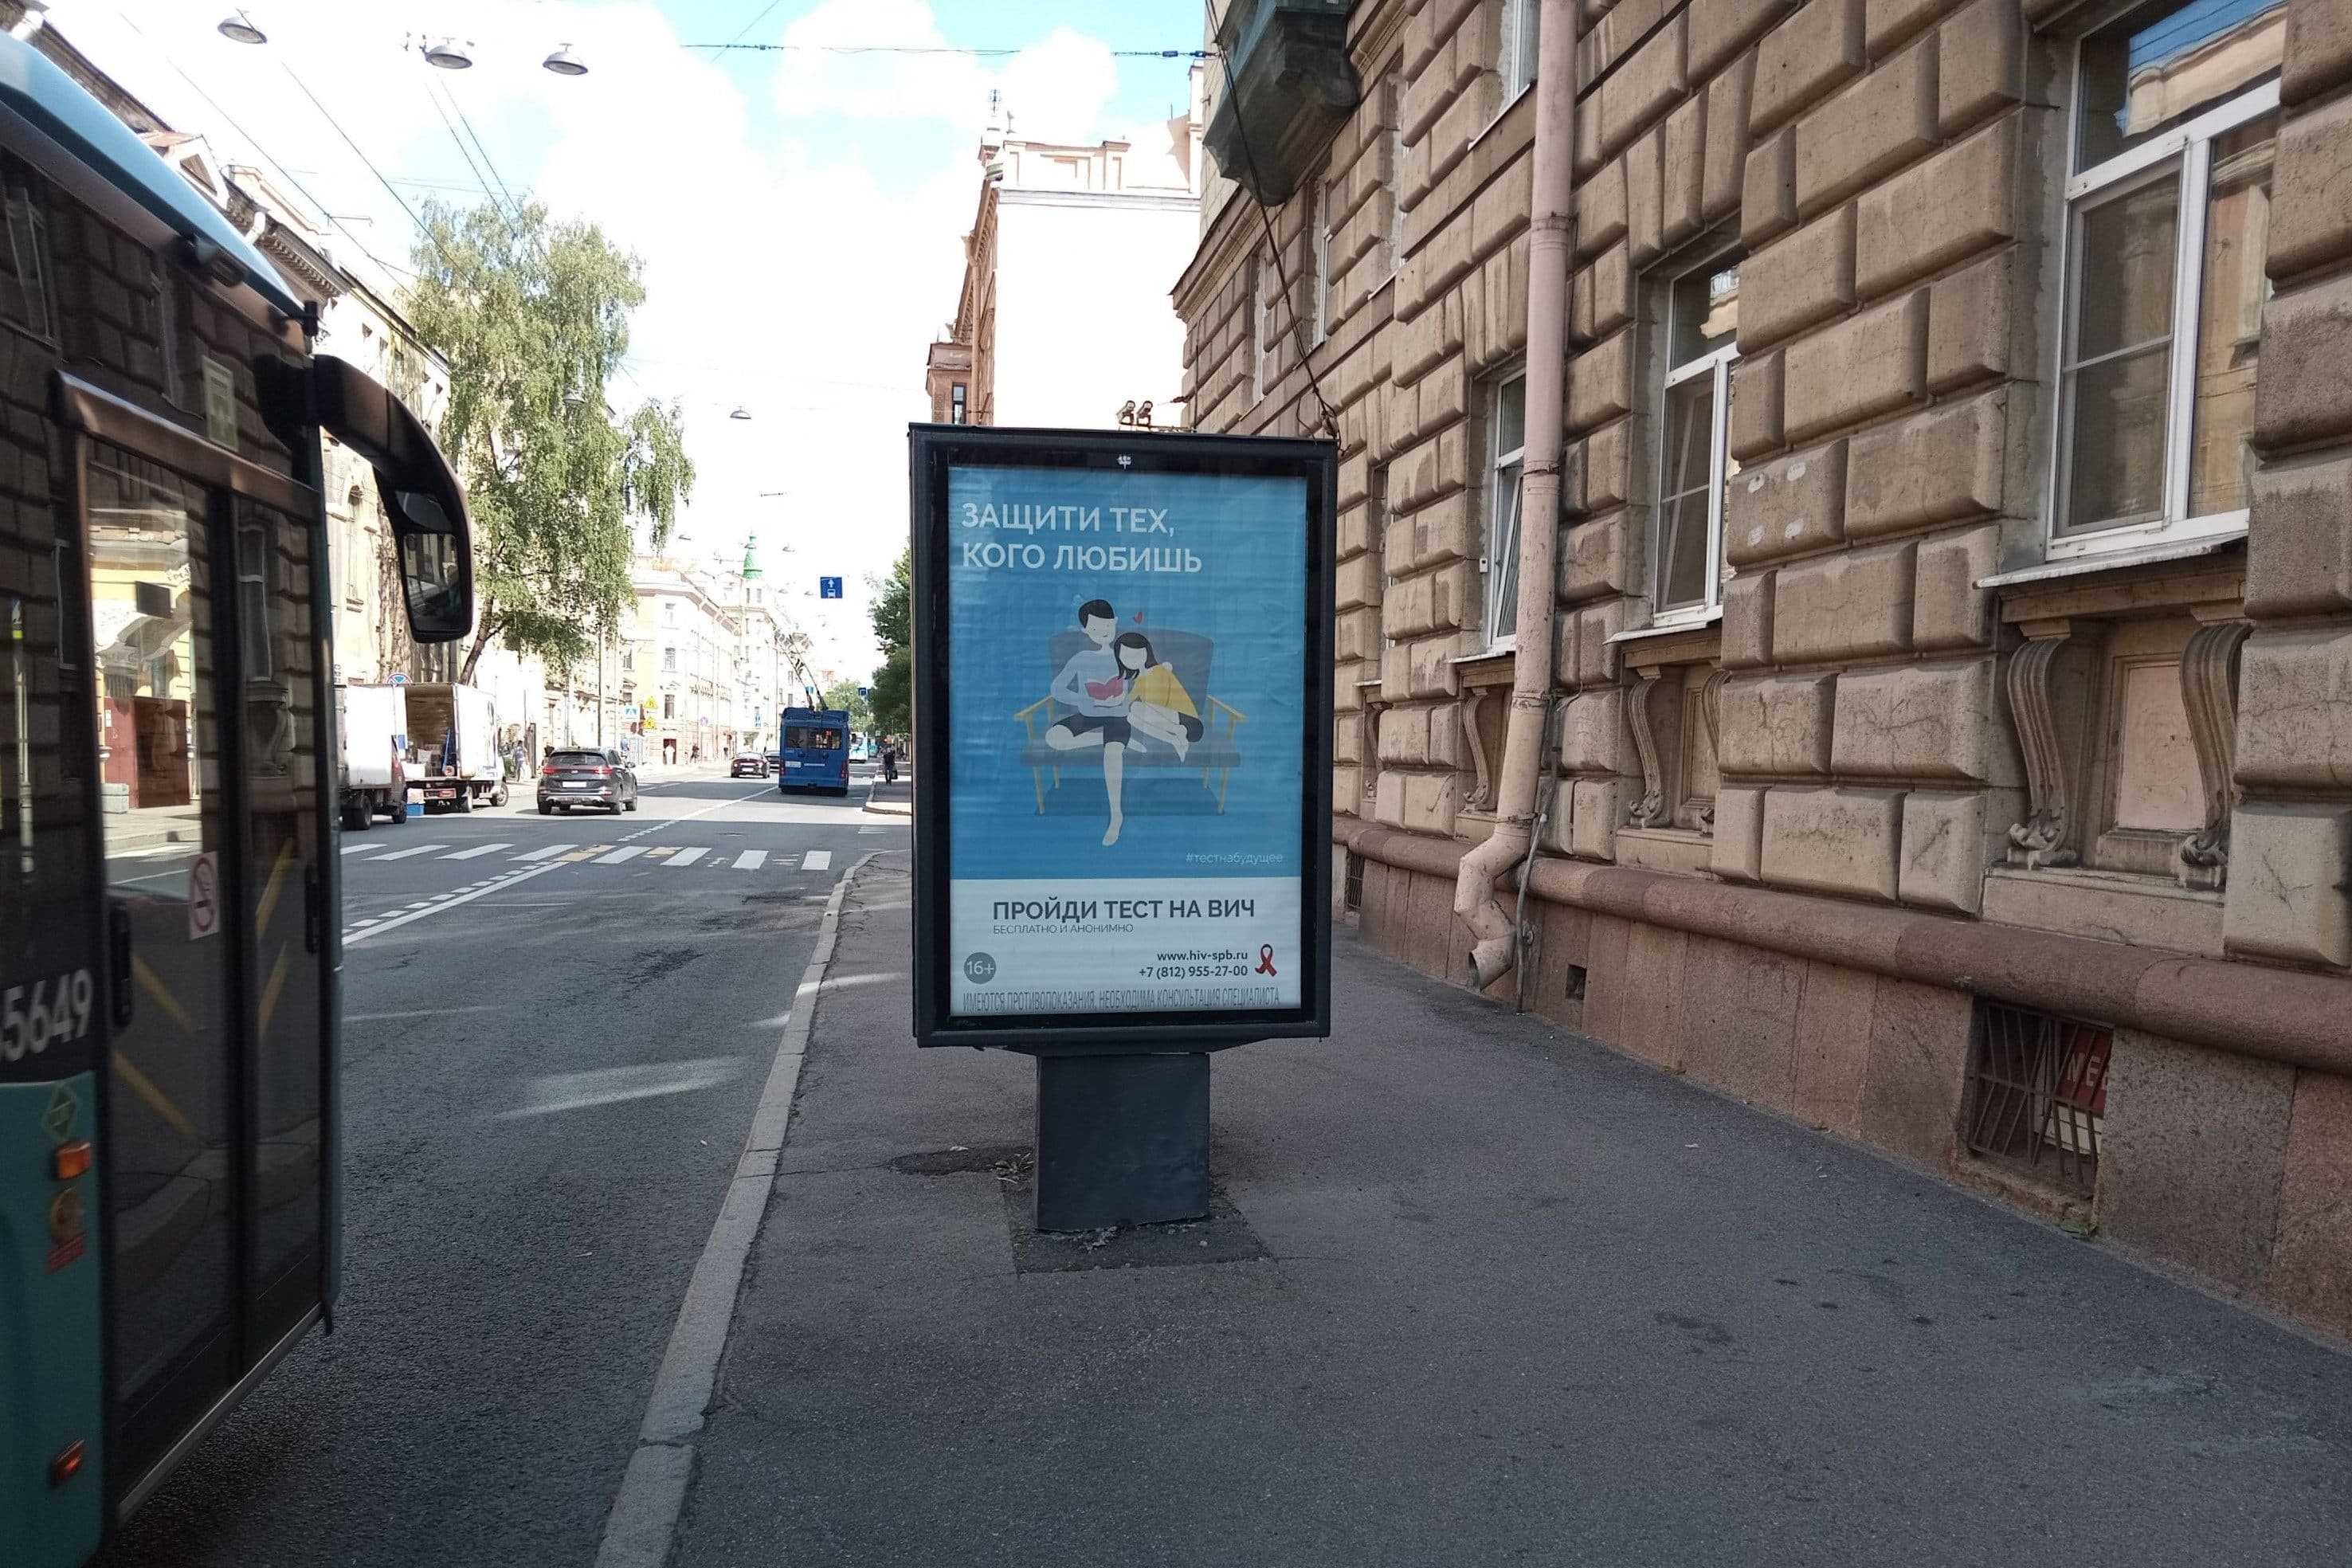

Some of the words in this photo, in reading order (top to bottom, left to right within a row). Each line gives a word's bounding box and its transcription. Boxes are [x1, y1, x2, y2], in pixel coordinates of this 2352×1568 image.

[961, 502, 1100, 535] ЗАЩИТИ
[1109, 507, 1175, 537] ТЕХ,
[962, 542, 1045, 570] КОГО
[1053, 545, 1203, 573] ЛЮБИШЬ
[1186, 852, 1284, 865] #тестнабудущее
[994, 896, 1097, 923] ПРОЙДИ
[1103, 900, 1163, 919] ТЕСТ
[1170, 900, 1201, 918] НА
[1208, 899, 1255, 917] ВИЧ
[994, 924, 1057, 935] БЕСПЛАТНО
[1060, 924, 1068, 934] И
[1070, 923, 1134, 934] АНОНИМНО
[1157, 950, 1249, 962] www.hiv-spb.ru
[967, 960, 994, 974] 16+
[1139, 966, 1154, 978] +7
[1156, 966, 1186, 980] (812)
[1188, 965, 1249, 977] 955-27-00
[962, 991, 1005, 1013] ИМЕЮТСЯ
[1099, 989, 1154, 1010] НЕОБХОДИМА
[1157, 987, 1221, 1009] КОНСУЛЬТАЦИЯ
[1222, 986, 1280, 1009] СПЕЦИАЛИСТА
[0, 968, 93, 1063] 5649
